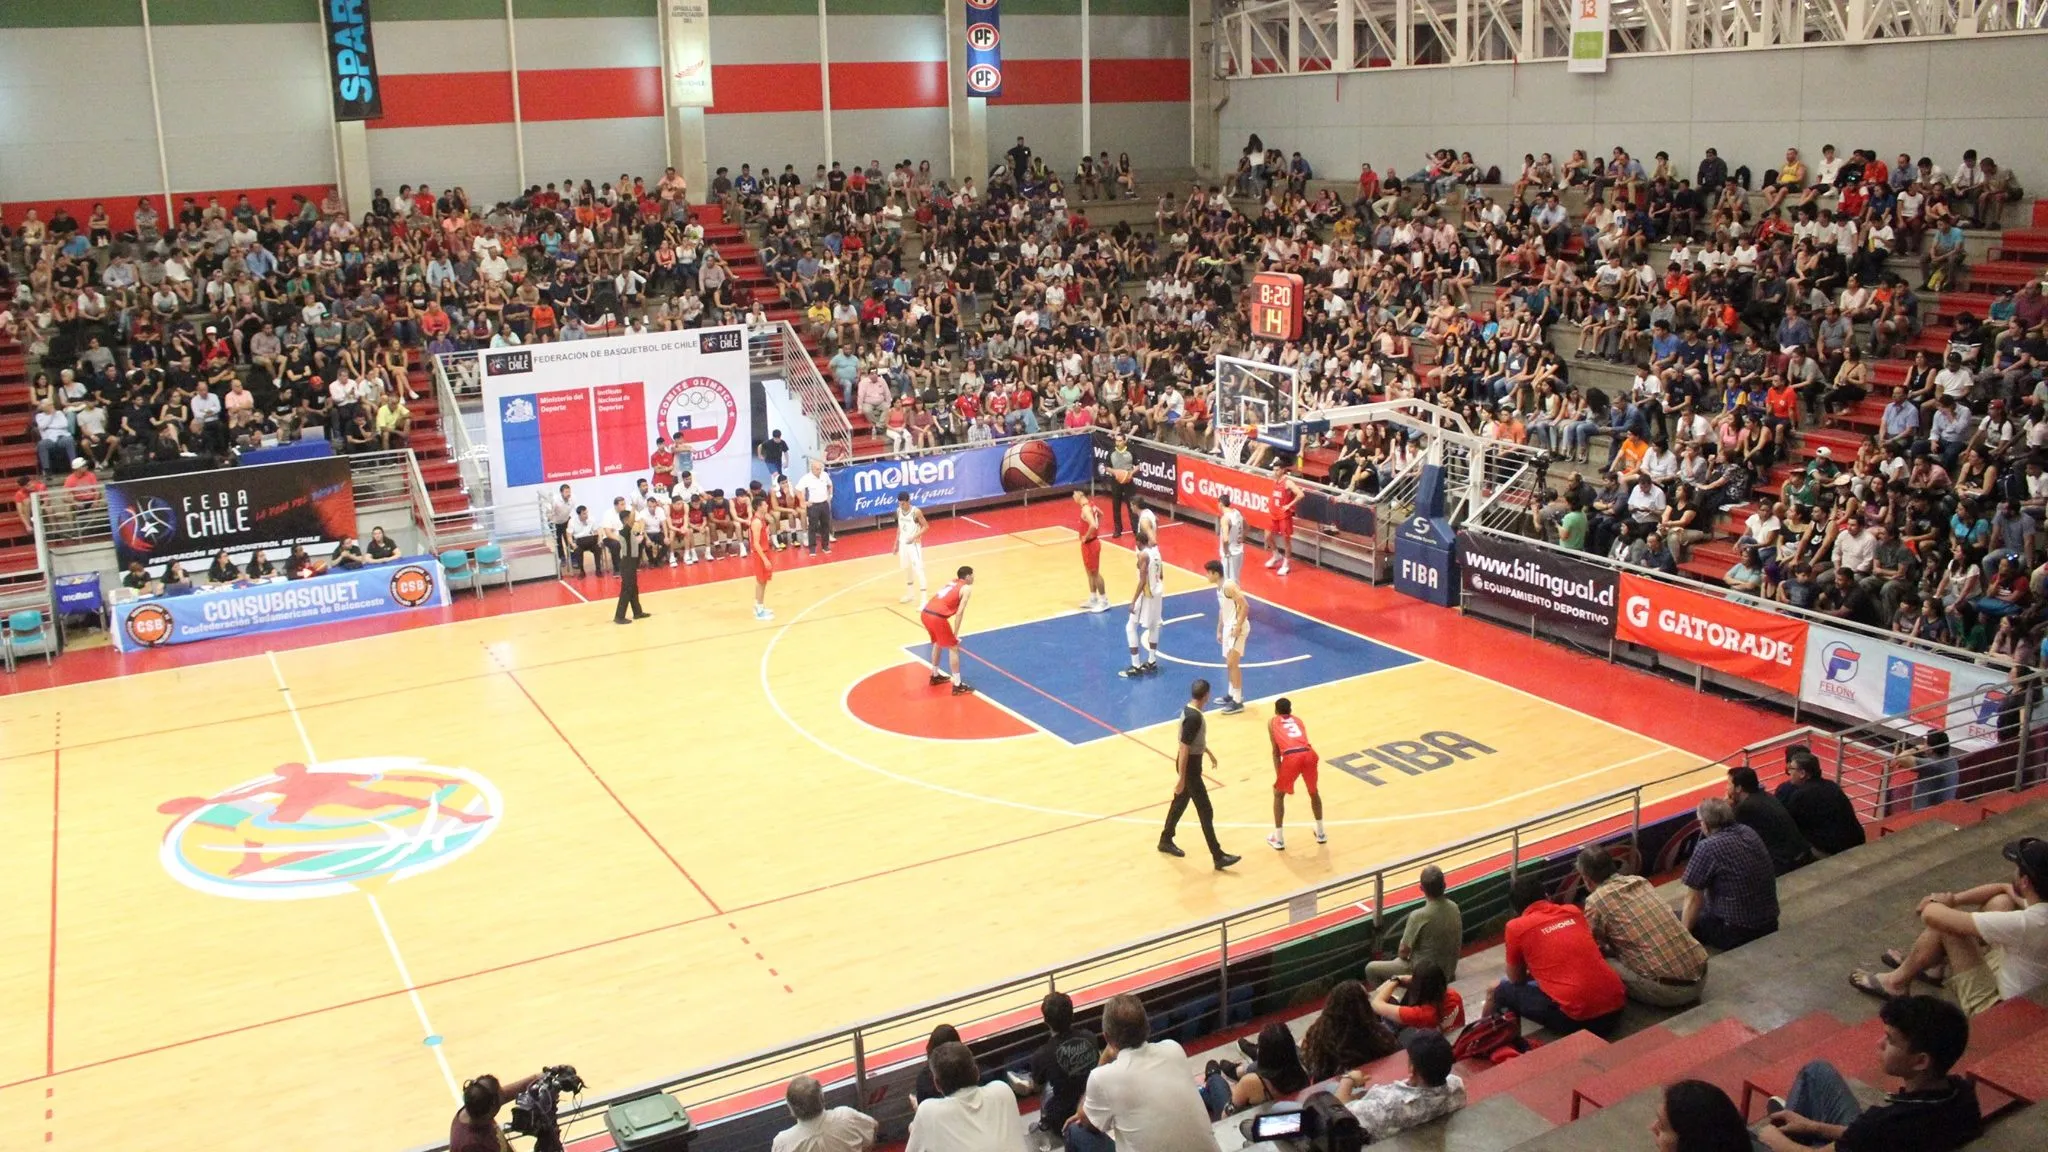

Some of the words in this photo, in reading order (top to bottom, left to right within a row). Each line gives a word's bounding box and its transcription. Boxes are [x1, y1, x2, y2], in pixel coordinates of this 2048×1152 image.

[974, 28, 992, 45] PF
[975, 70, 992, 87] PF
[1261, 284, 1291, 307] 8:20
[1266, 308, 1282, 334] 14
[590, 350, 602, 358] DE
[603, 344, 659, 357] BASQUETBOL
[661, 343, 672, 351] DE
[674, 341, 698, 350] CHILE
[540, 395, 573, 404] Ministerio
[573, 393, 584, 401] del
[540, 404, 567, 414] Deporte
[691, 446, 717, 461] HILE
[854, 458, 955, 494] molten
[1181, 470, 1195, 495] G
[183, 489, 248, 512] FEBA
[854, 496, 874, 512] For
[874, 492, 895, 507] the
[921, 486, 956, 503] game
[185, 506, 251, 539] CHILE
[295, 535, 321, 544] CHILE
[1402, 559, 1438, 589] FIBA
[1465, 551, 1615, 607] www.bilingual.cl
[400, 580, 424, 594] CSB
[203, 580, 359, 622] CONSUBASQUET
[1483, 580, 1552, 609] EQUIPAMIENTO
[1553, 601, 1610, 626] DEPORTIVO
[136, 619, 164, 633] CSB
[181, 618, 250, 636] Confederación
[252, 606, 319, 625] Sudamericana
[320, 603, 332, 614] de
[333, 597, 385, 613] Baloncesto
[1625, 595, 1650, 628] G
[1657, 608, 1793, 667] GATORADE
[1819, 680, 1856, 699] FELONY
[1325, 730, 1499, 787] FIBA
